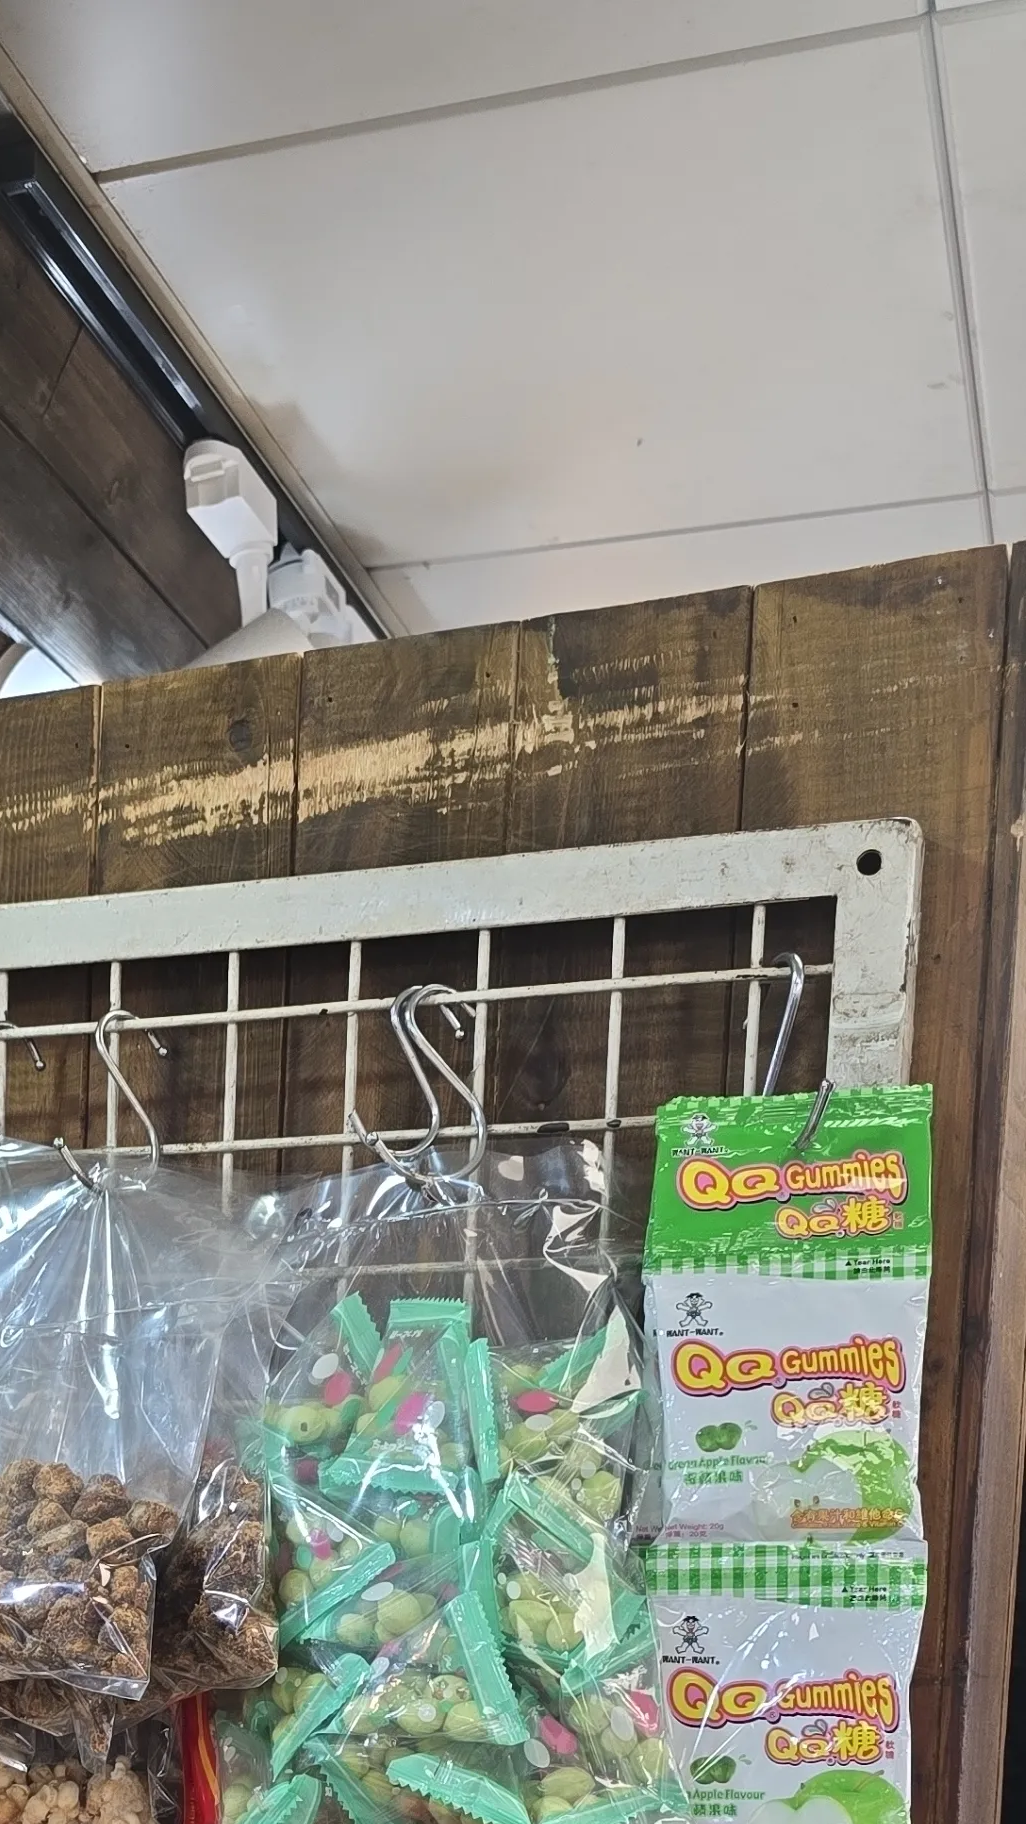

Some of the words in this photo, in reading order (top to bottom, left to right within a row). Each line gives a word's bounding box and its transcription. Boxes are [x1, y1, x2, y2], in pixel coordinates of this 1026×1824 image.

[672, 1146, 728, 1157] WANT-WANT
[679, 1159, 781, 1206] QQ
[784, 1151, 904, 1201] Gummies
[776, 1195, 891, 1237] QQ糖
[666, 1328, 720, 1338] WANT-WANT
[674, 1340, 777, 1391] QQ
[779, 1335, 903, 1389] Gummies
[772, 1380, 889, 1426] QQ糖
[668, 1461, 697, 1471] Green
[698, 1457, 729, 1469] Apple
[730, 1455, 769, 1466] Flavou
[662, 1655, 716, 1665] WANT-WANT
[669, 1668, 768, 1722] QQ
[775, 1670, 894, 1727] Gummies
[766, 1719, 882, 1763] QQ糖
[693, 1788, 723, 1800] Apple
[725, 1789, 766, 1800] Flavour
[693, 1803, 738, 1816] 蘋果味
